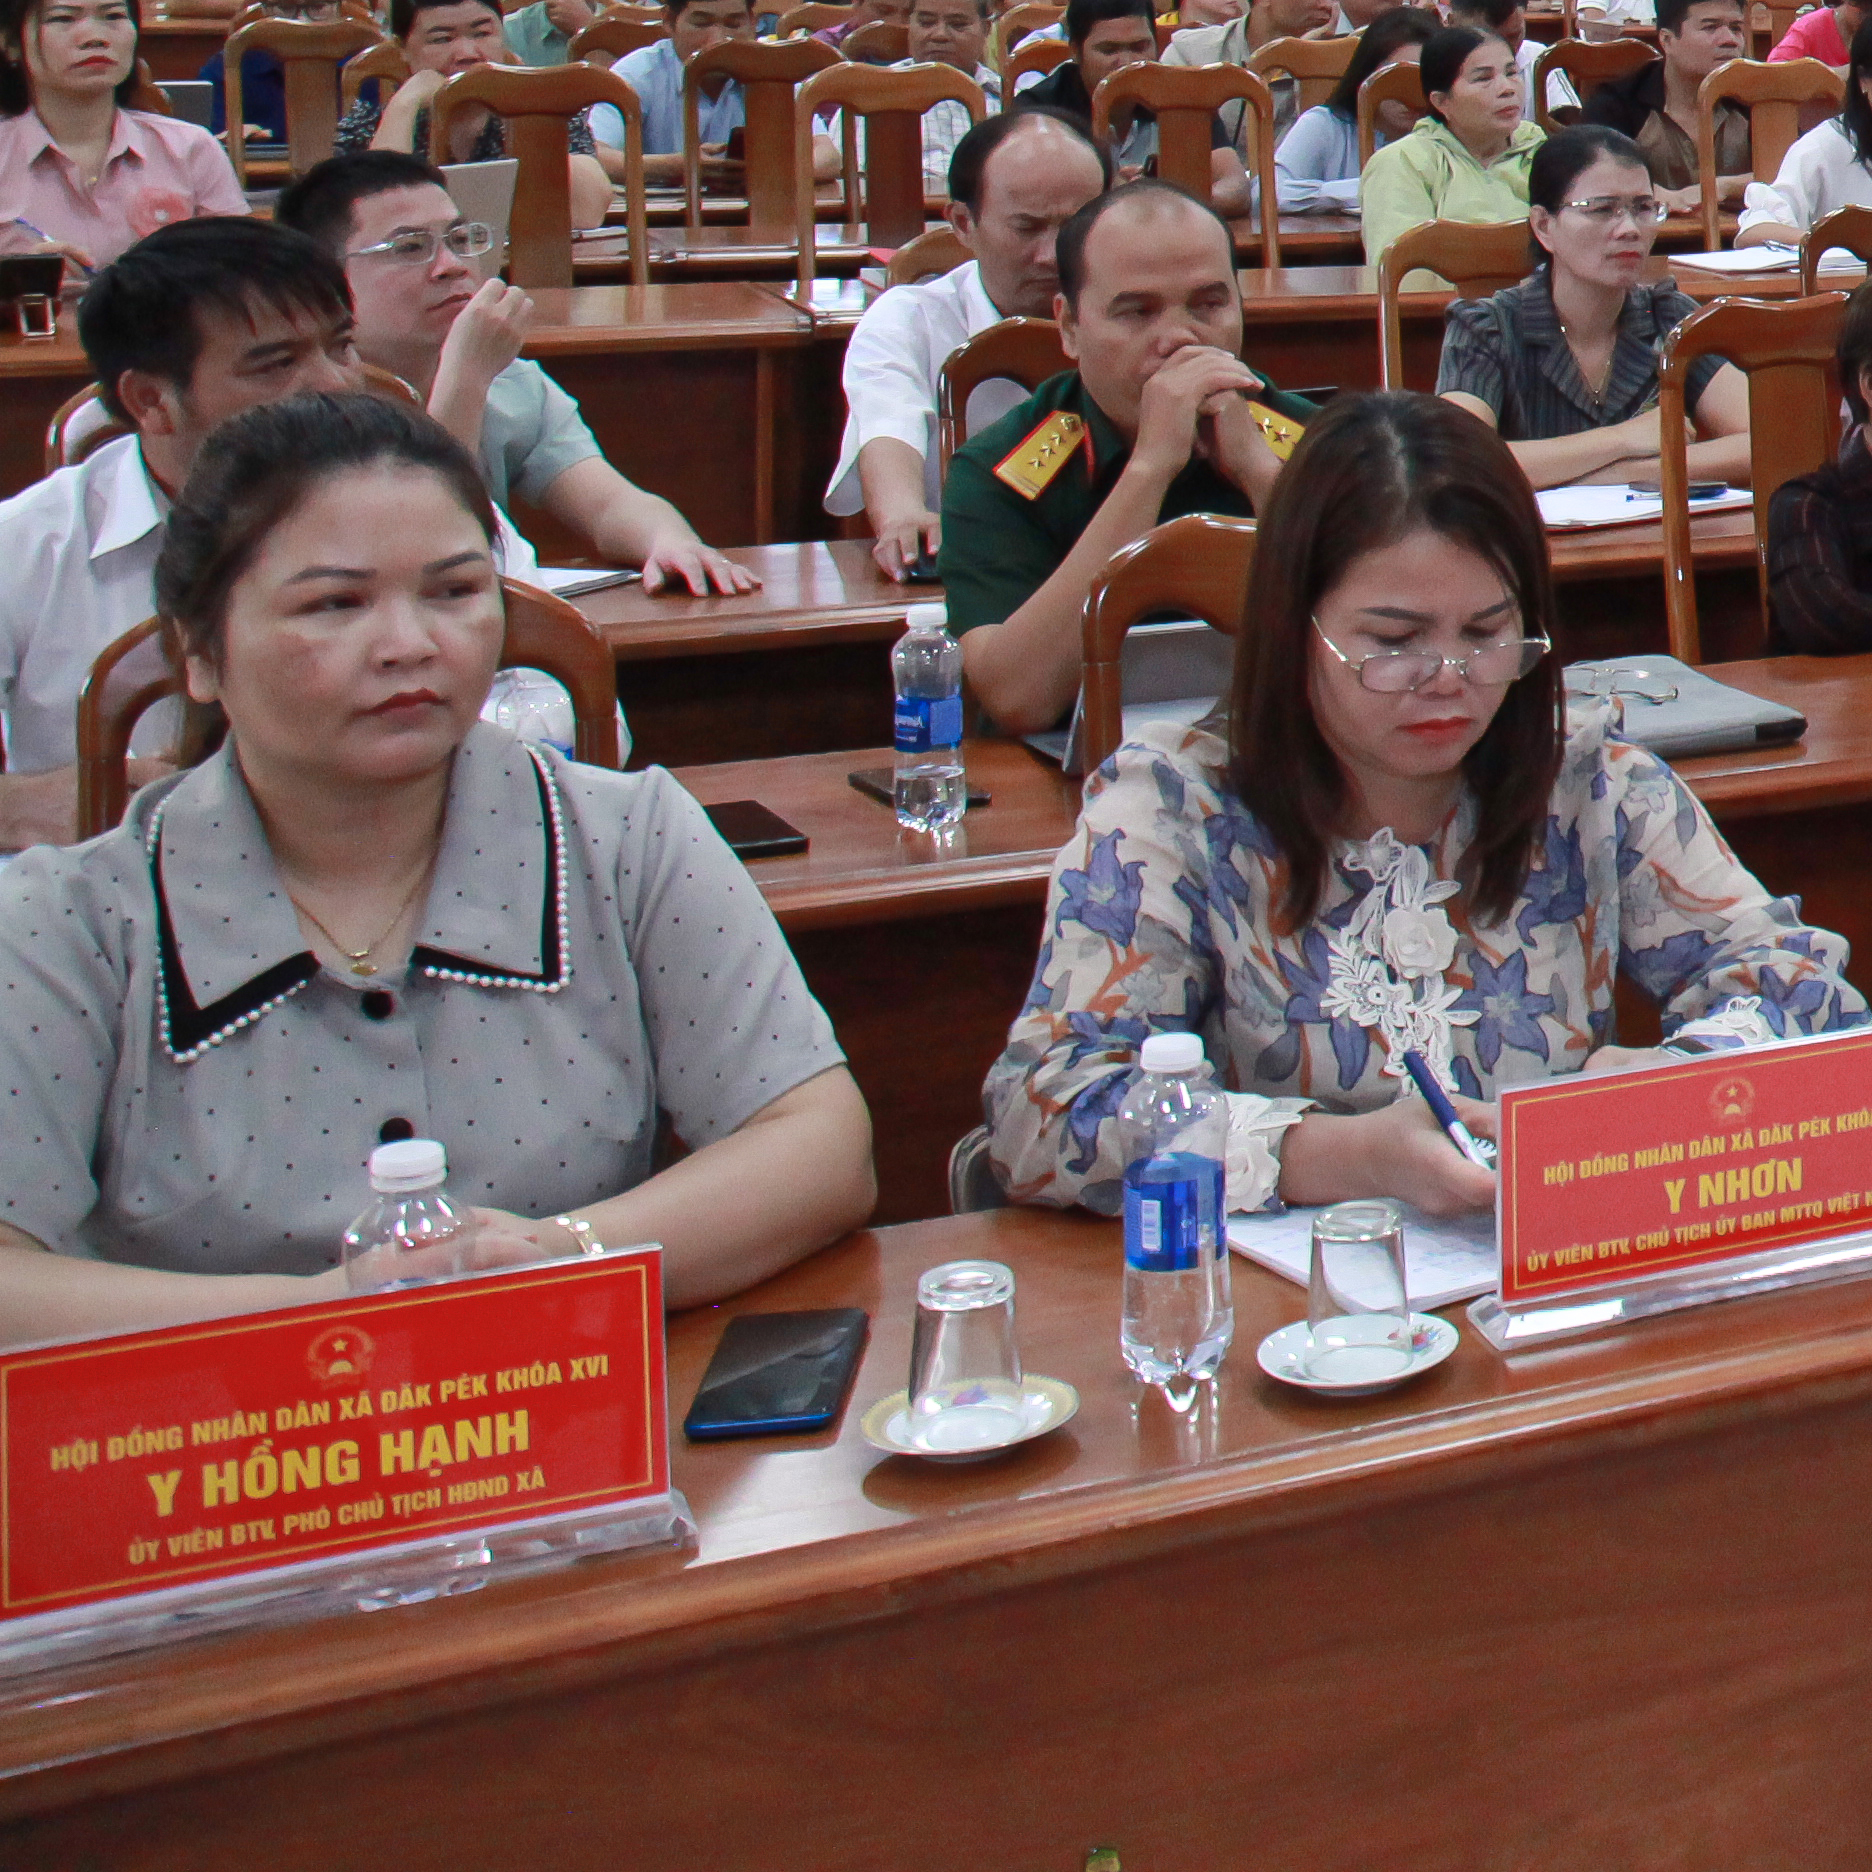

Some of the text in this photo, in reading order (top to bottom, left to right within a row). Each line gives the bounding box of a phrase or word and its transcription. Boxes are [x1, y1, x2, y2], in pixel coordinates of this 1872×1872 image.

[1543, 1160, 1574, 1187] HỘI
[1579, 1151, 1629, 1179] ĐỒNG
[1634, 1142, 1684, 1169] NHÂN
[1688, 1134, 1726, 1159] DÂN
[1731, 1128, 1754, 1152] XÃ
[1799, 1116, 1830, 1140] PÉK
[1664, 1157, 1802, 1214] Y NHƠN
[1526, 1249, 1549, 1272] ỦY
[1554, 1243, 1594, 1267] VIÊN
[1635, 1225, 1670, 1251] CHỦ
[1674, 1222, 1711, 1246] TỊCH
[1741, 1210, 1775, 1231] BAN
[1780, 1201, 1823, 1223] MTTQ
[1828, 1192, 1860, 1215] VIỆT
[51, 1438, 99, 1472] HỘI
[107, 1425, 184, 1462] ĐỒNG
[191, 1410, 269, 1446] NHÂN
[275, 1400, 331, 1431] DÂN
[338, 1389, 373, 1421] XÃ
[440, 1373, 488, 1403] PÉK
[496, 1360, 562, 1393] KHÓA
[569, 1354, 609, 1381] XVI
[147, 1409, 529, 1517] Y HỒNG HẠNH
[128, 1536, 160, 1565] ỦY
[168, 1527, 224, 1557] VIÊN
[283, 1505, 331, 1535] PHÓ
[337, 1491, 385, 1526] CHỦ
[391, 1488, 441, 1518] TỊCH
[448, 1475, 509, 1505] HĐND
[516, 1465, 546, 1492] XÃ
